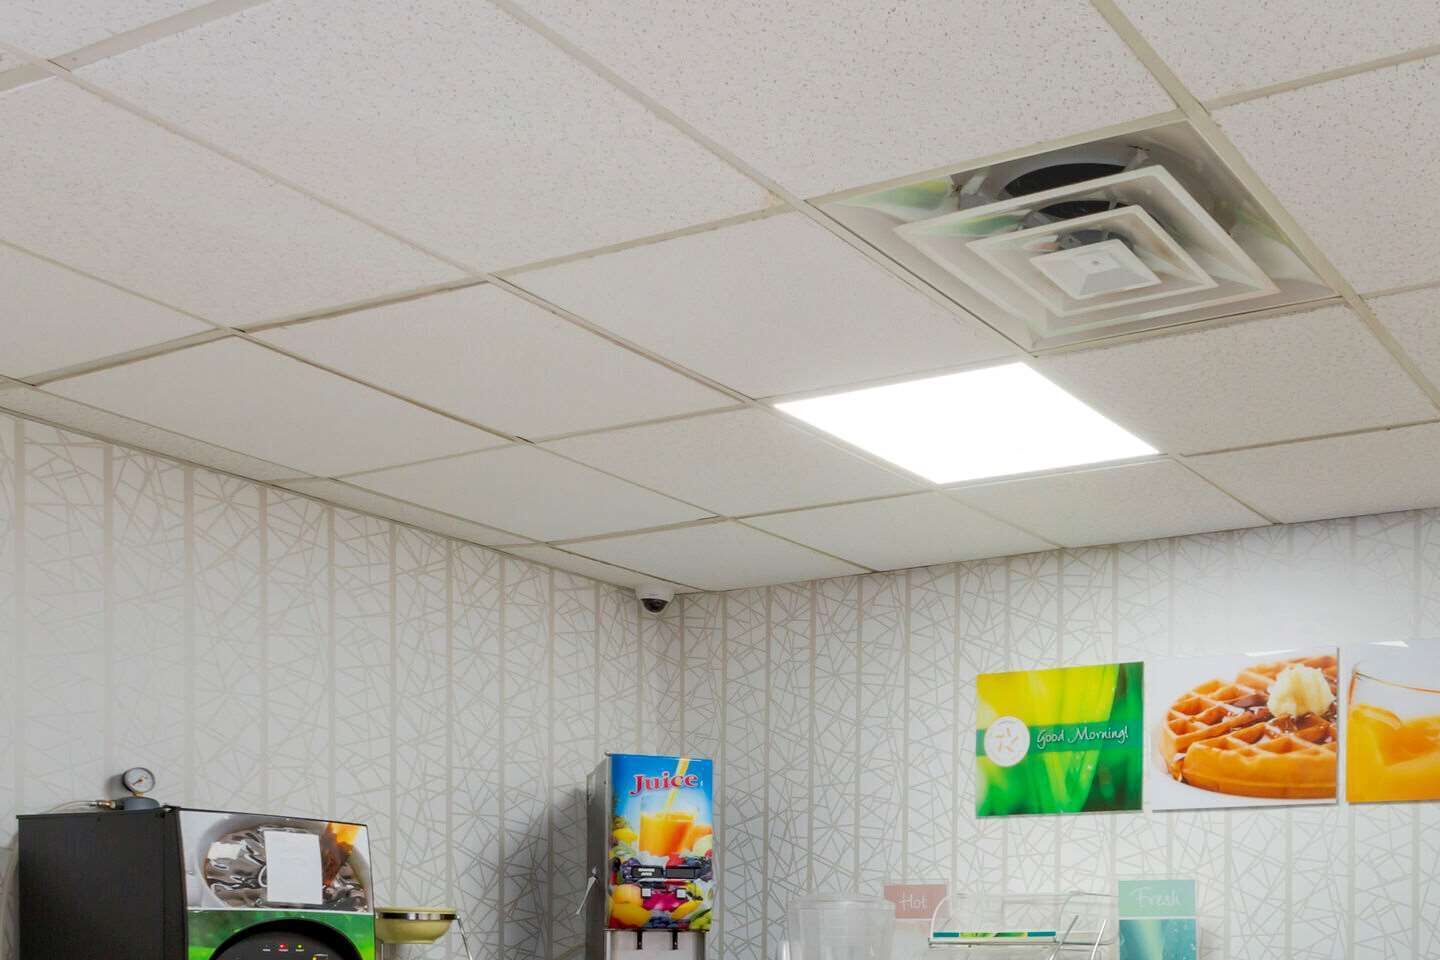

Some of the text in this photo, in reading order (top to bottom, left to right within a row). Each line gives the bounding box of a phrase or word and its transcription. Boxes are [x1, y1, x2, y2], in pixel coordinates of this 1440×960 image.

[1037, 725, 1128, 750] Good Morning!
[629, 770, 699, 796] Juice
[897, 893, 929, 911] Hot
[1130, 886, 1181, 907] Fresh
